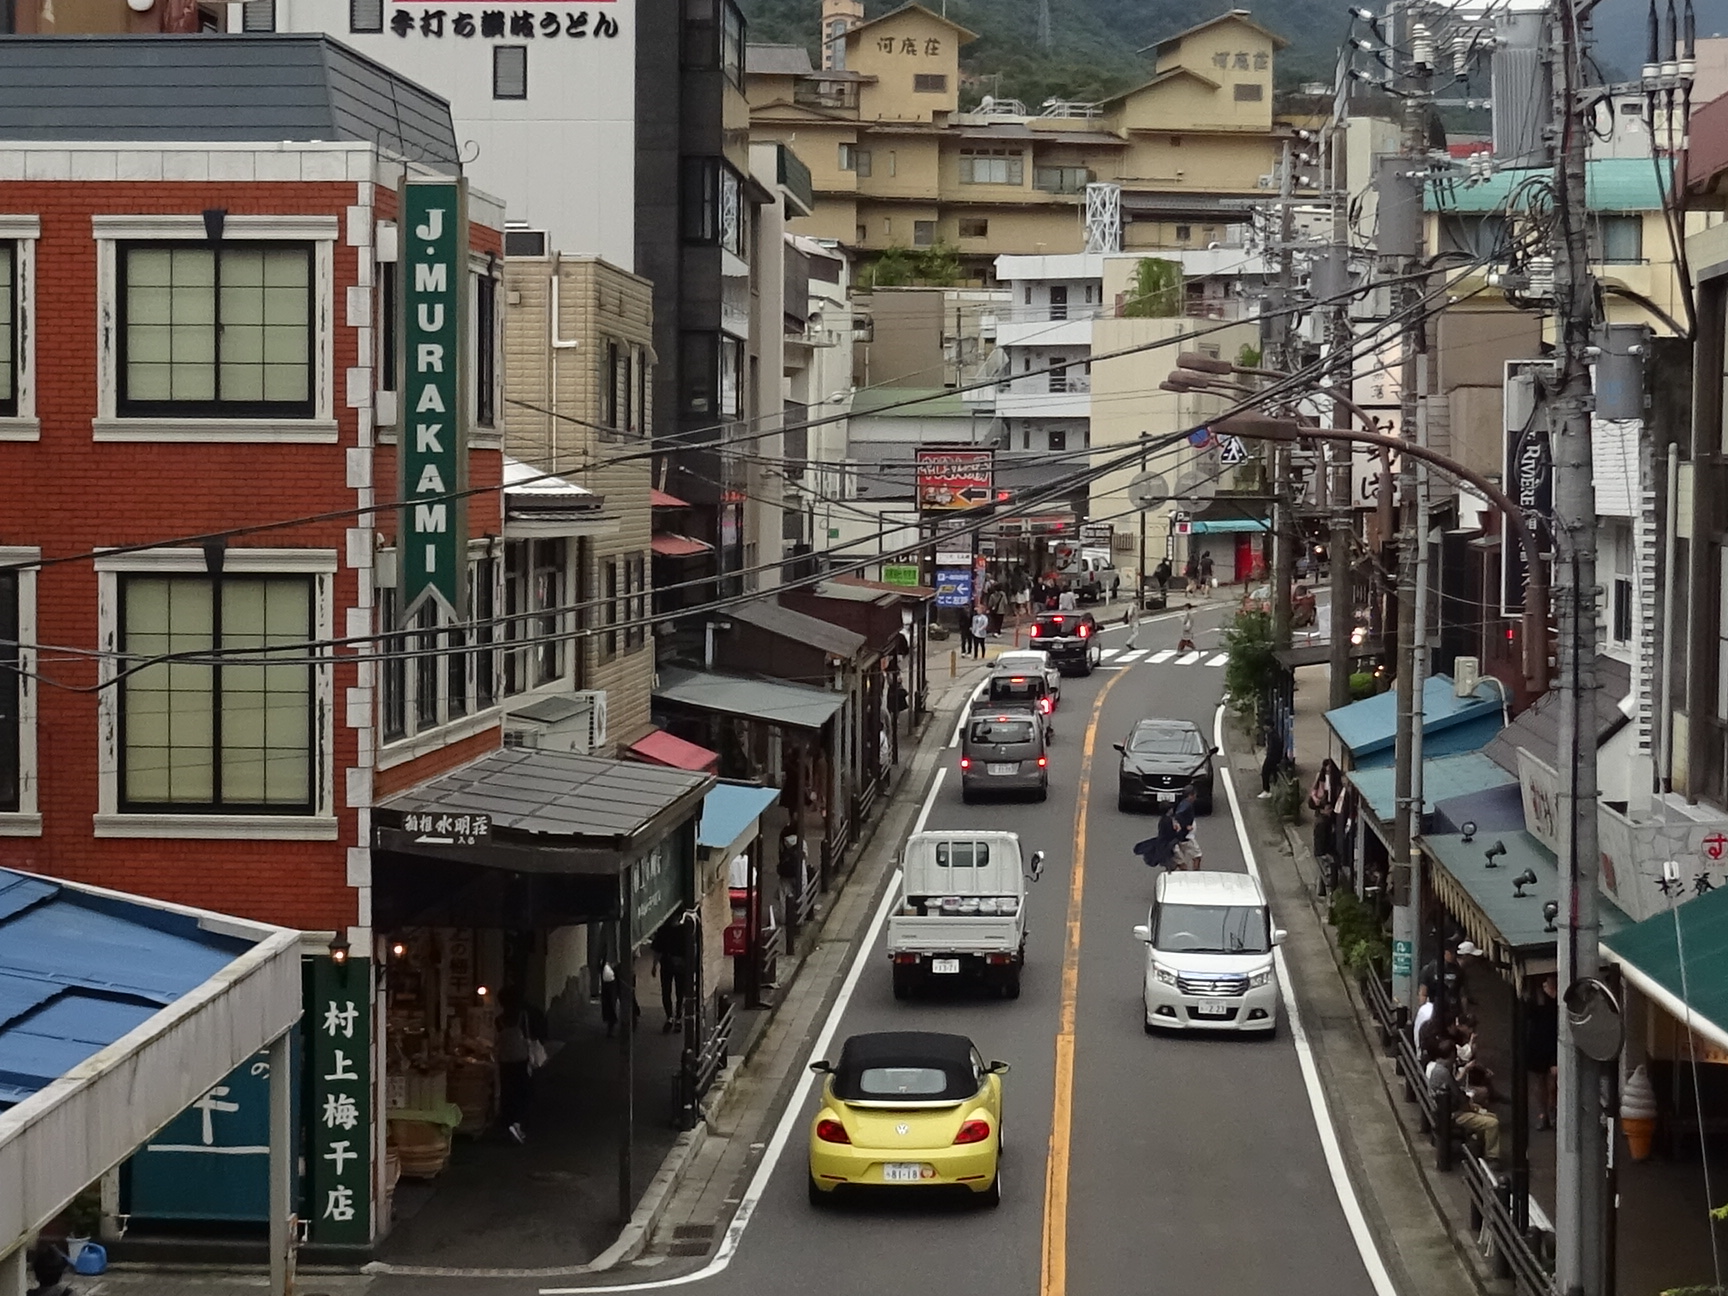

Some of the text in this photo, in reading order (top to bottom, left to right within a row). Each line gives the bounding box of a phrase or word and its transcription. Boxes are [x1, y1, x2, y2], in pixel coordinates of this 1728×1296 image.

[390, 9, 619, 39] 手打ち讃岐うどん
[321, 1000, 359, 1222] 村上梅干店
